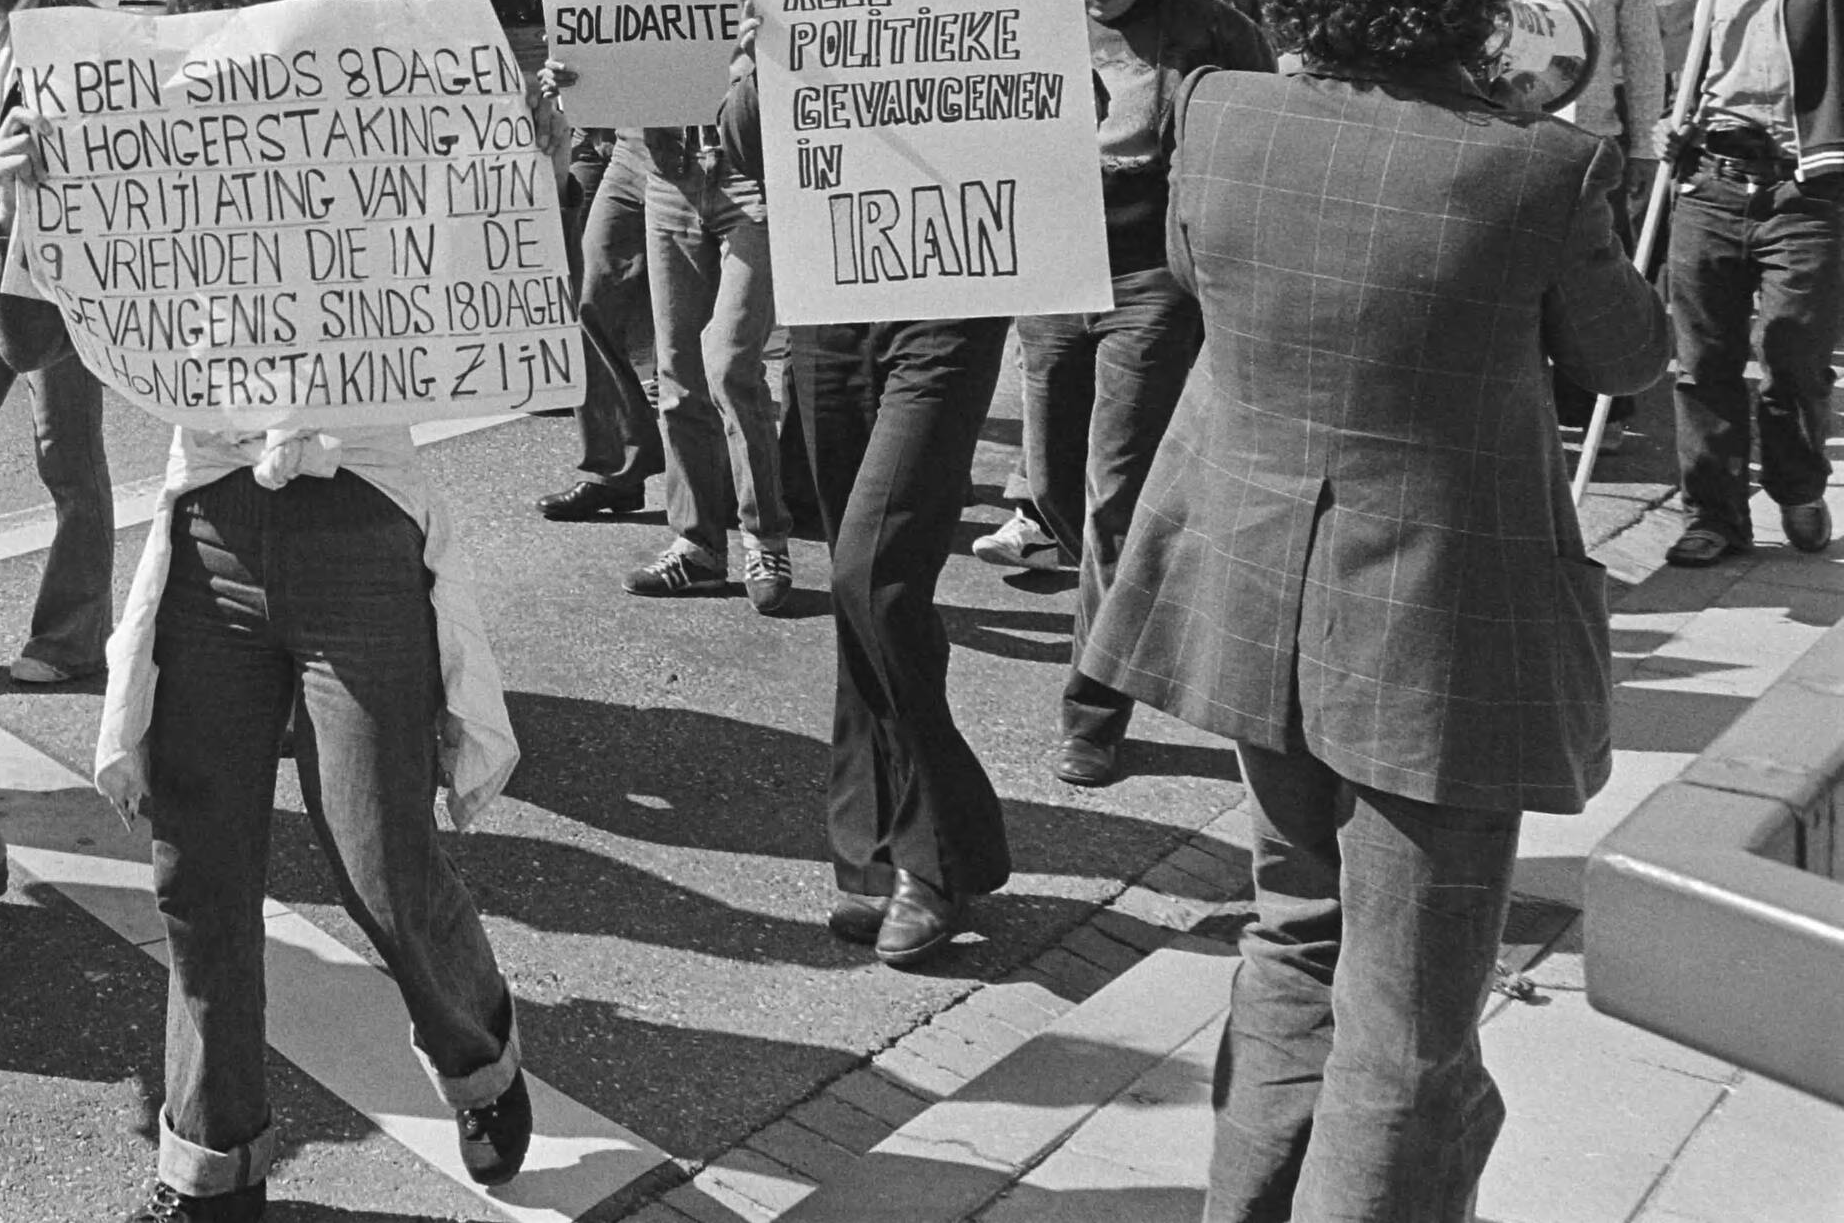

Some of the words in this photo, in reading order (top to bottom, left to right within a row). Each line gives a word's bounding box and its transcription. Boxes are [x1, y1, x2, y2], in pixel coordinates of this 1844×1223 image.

[73, 57, 162, 115] BEN
[182, 49, 324, 105] SINDS
[793, 72, 1064, 131] GEVANGENEN
[36, 126, 70, 175] N
[82, 105, 459, 173] HONGERSTAKING
[461, 103, 534, 152] VOO
[348, 164, 428, 218] VAN
[447, 155, 537, 218] MIJN
[83, 230, 283, 292] VRIENDEN
[306, 226, 371, 282] DIE
[390, 223, 435, 277] IN
[482, 217, 544, 271] DE
[828, 178, 1018, 285] IRAN
[319, 283, 436, 339] SINDS
[450, 337, 571, 410] ZIJN
